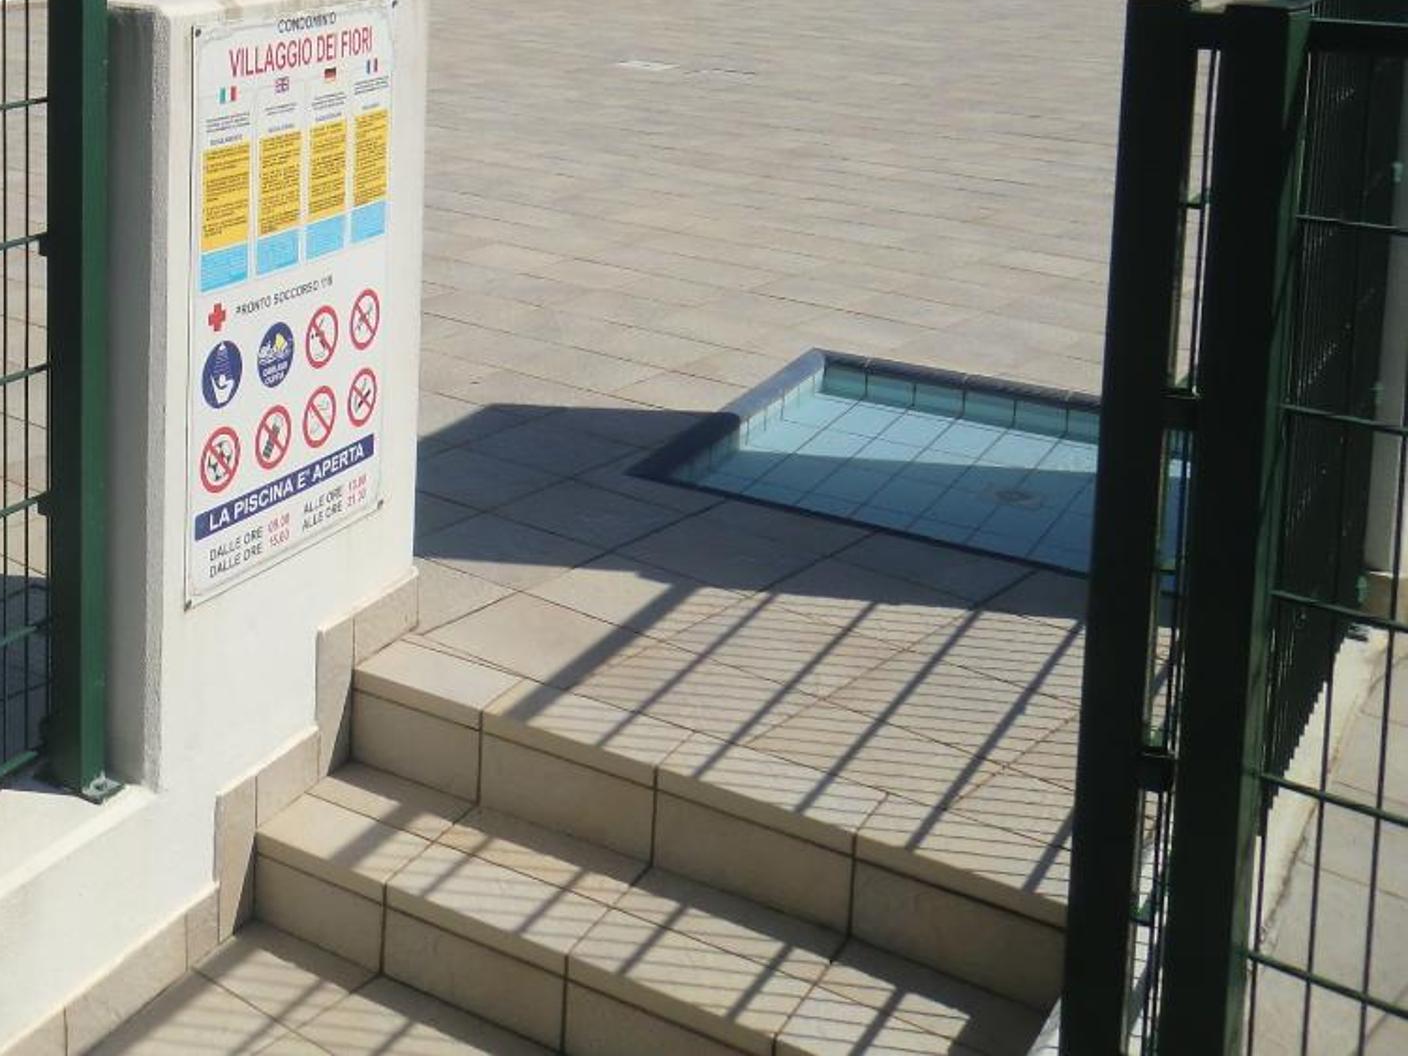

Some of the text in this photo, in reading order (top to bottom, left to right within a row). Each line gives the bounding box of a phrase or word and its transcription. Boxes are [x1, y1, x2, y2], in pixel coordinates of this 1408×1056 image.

[229, 26, 373, 77] VILLAGGIO DEI FIORI
[235, 295, 271, 314] PRONTO
[273, 280, 319, 305] SOCCORSO
[209, 511, 230, 531] LA
[234, 479, 294, 520] PISCINA
[312, 443, 365, 483] APERTA
[209, 536, 241, 562] DALLE
[244, 527, 263, 545] ORE
[303, 498, 324, 514] ALLE
[326, 485, 342, 503] ORE
[209, 553, 241, 578] DALLE
[244, 543, 263, 562] ORE
[302, 510, 324, 532] ALLE
[325, 501, 342, 519] ORE
